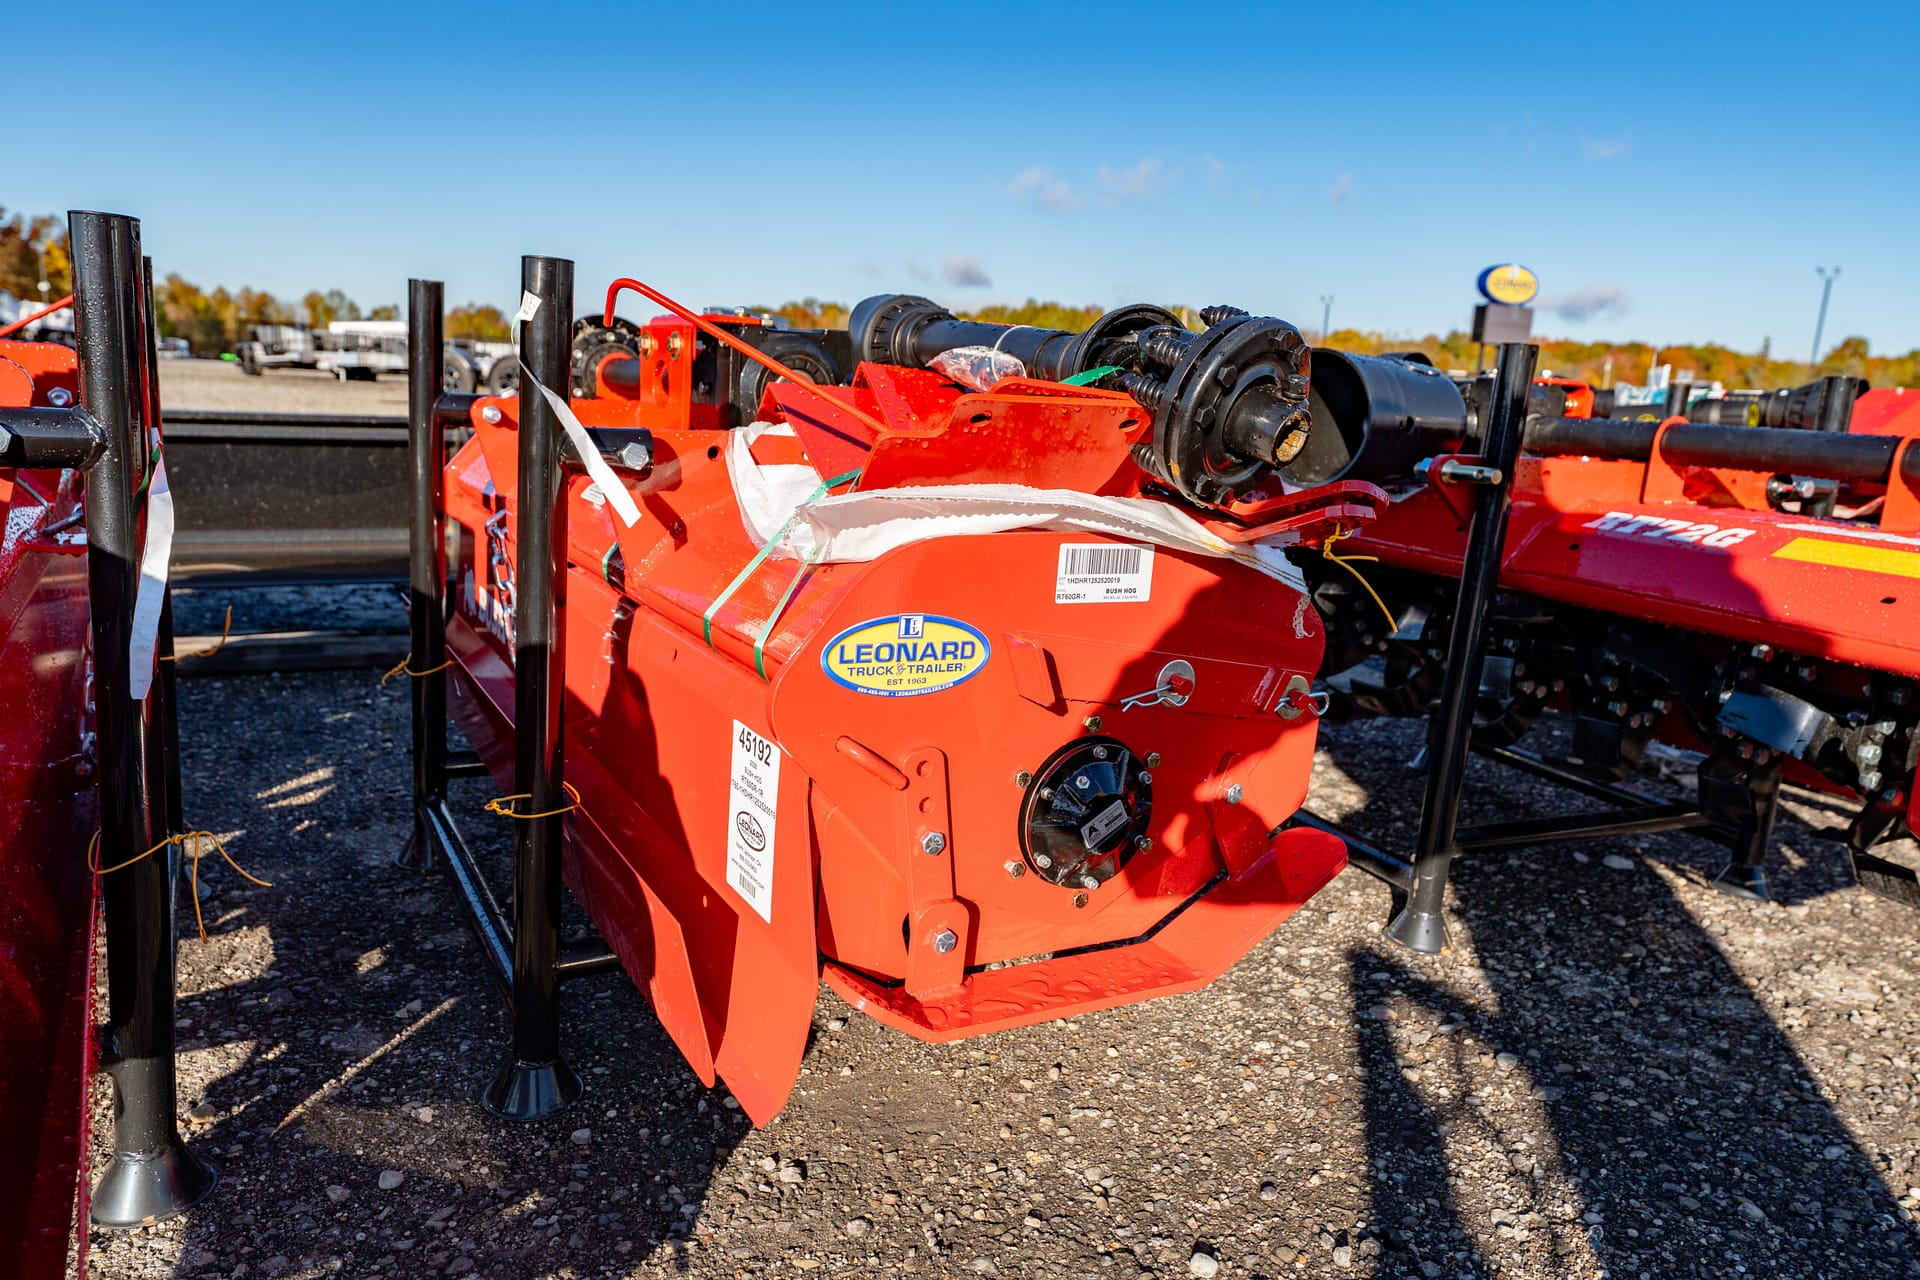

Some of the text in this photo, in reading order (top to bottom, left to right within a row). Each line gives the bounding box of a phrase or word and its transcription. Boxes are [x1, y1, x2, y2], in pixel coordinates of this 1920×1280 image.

[1582, 511, 1756, 548] RT72G
[838, 641, 976, 664] LEONARD
[847, 666, 894, 677] TRUCK
[907, 662, 963, 674] TRAILER
[887, 677, 927, 686] EST 1963
[739, 727, 772, 767] 45192
[738, 816, 764, 844] LEONARD
